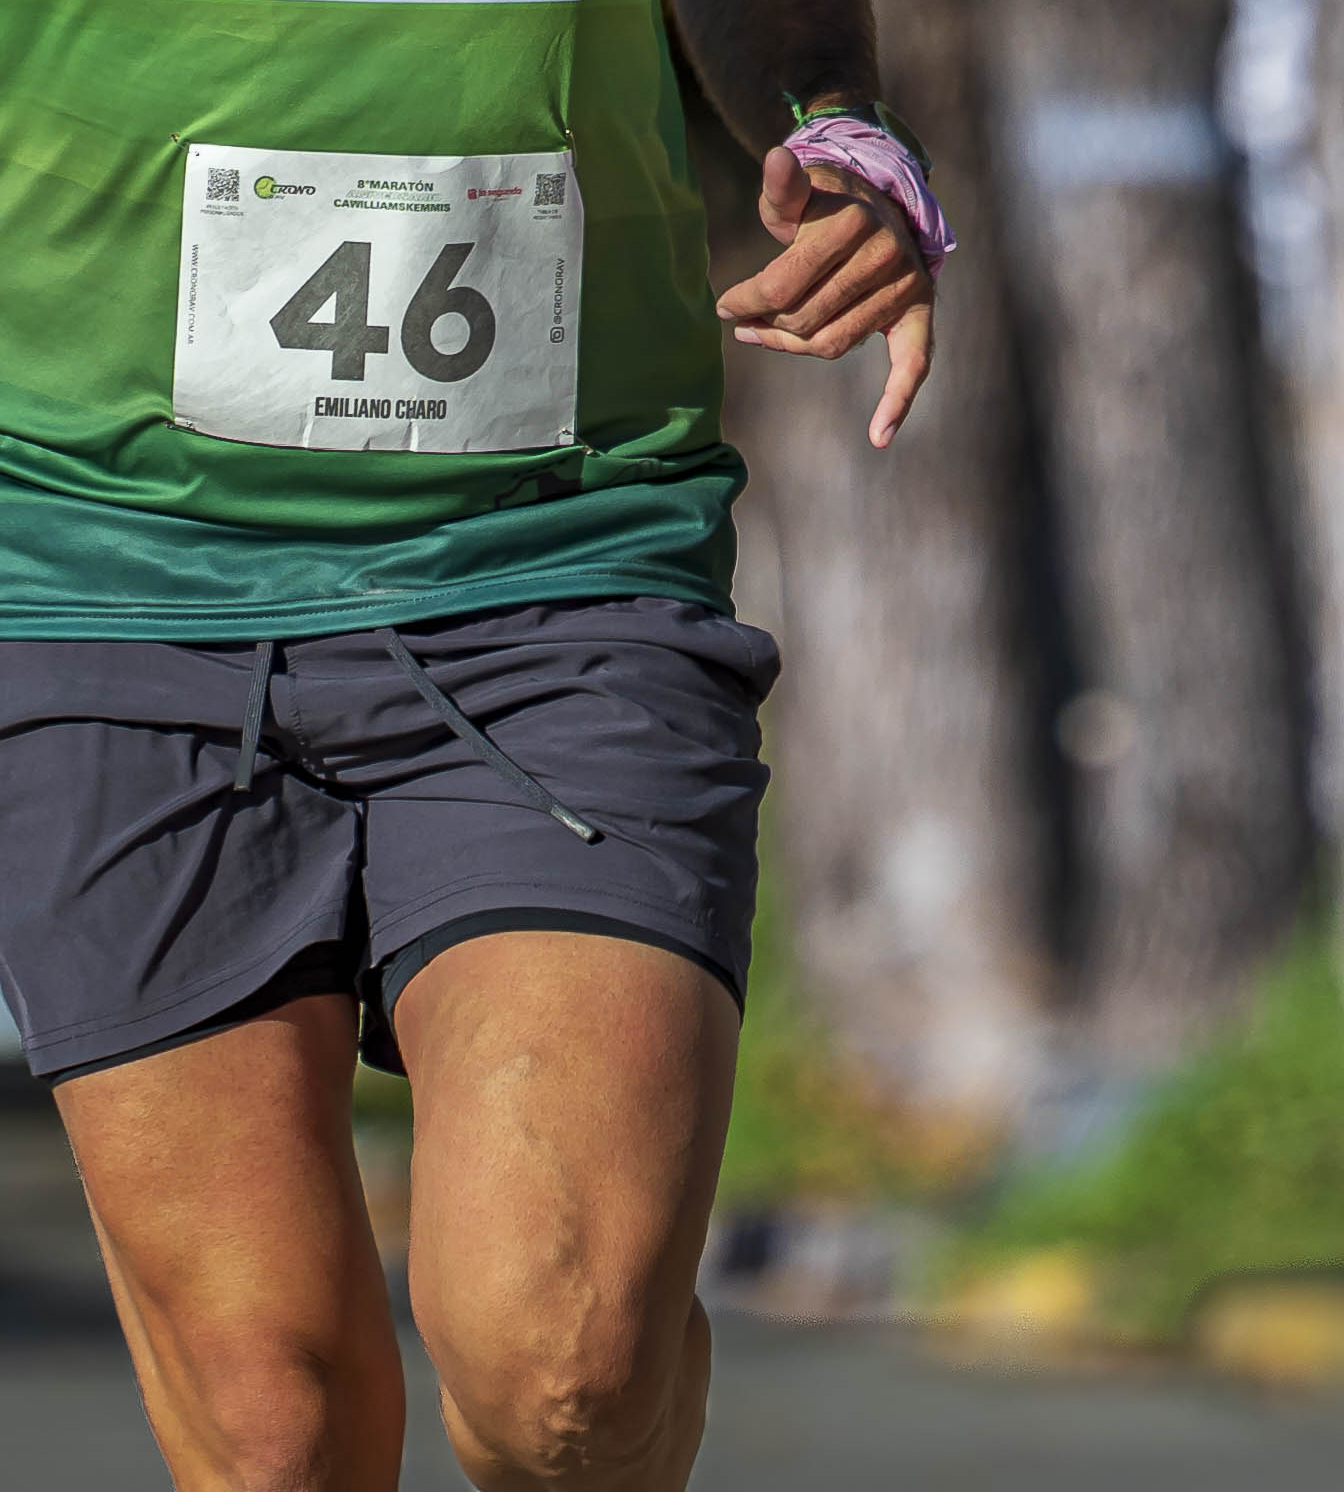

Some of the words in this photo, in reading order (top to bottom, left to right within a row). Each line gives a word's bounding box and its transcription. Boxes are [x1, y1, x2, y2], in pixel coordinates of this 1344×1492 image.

[333, 198, 451, 213] CAWILLIAMSKEMMIS
[269, 241, 496, 383] 46
[314, 396, 392, 419] EMILIANO
[395, 399, 448, 420] CHARO
